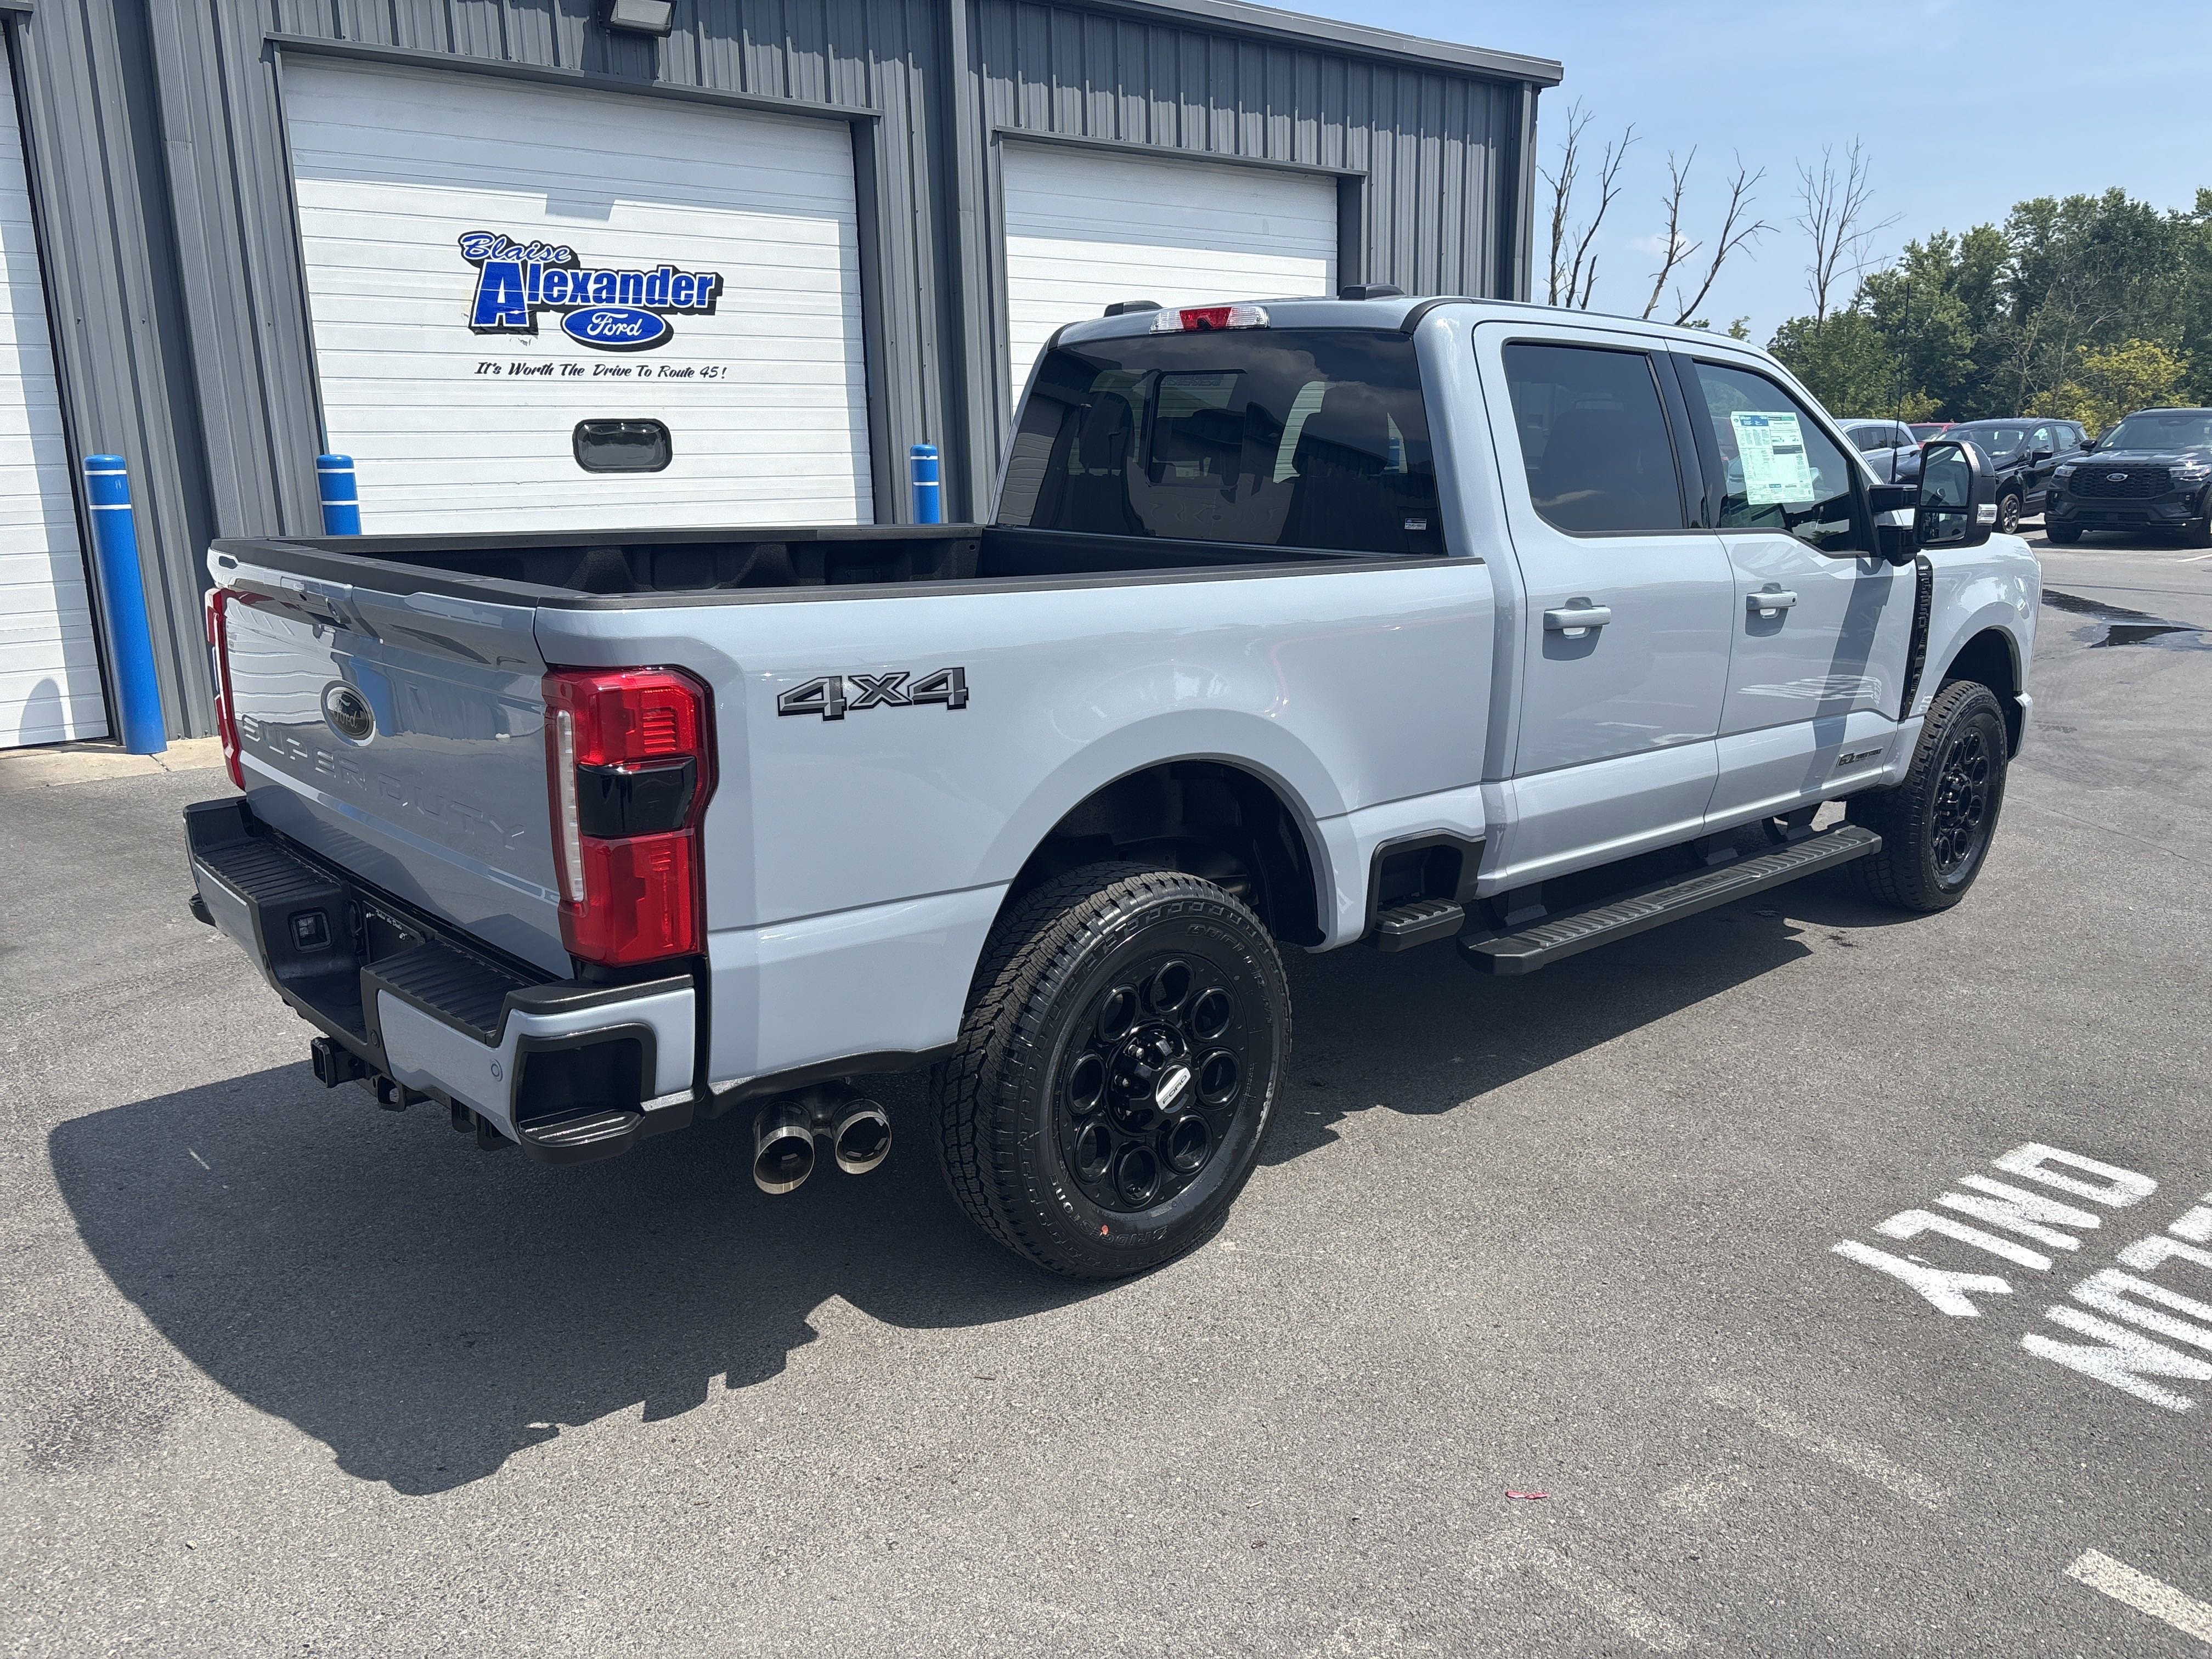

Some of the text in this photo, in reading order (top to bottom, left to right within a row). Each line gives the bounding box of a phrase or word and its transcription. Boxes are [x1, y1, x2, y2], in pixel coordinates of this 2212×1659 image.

[459, 232, 572, 264] Blaise
[470, 259, 717, 328] Alexander
[586, 311, 643, 337] Ford
[474, 362, 501, 375] It's
[508, 363, 555, 377] Worth
[559, 364, 585, 377] The
[592, 364, 632, 378] Drive
[636, 365, 652, 378] To
[658, 365, 695, 379] Route
[242, 714, 525, 851] SUPER DUTY
[1163, 1075, 1187, 1104] FORD
[1048, 1172, 1169, 1248] BRIDGESTONE
[1832, 1141, 2159, 1317] ONLY
